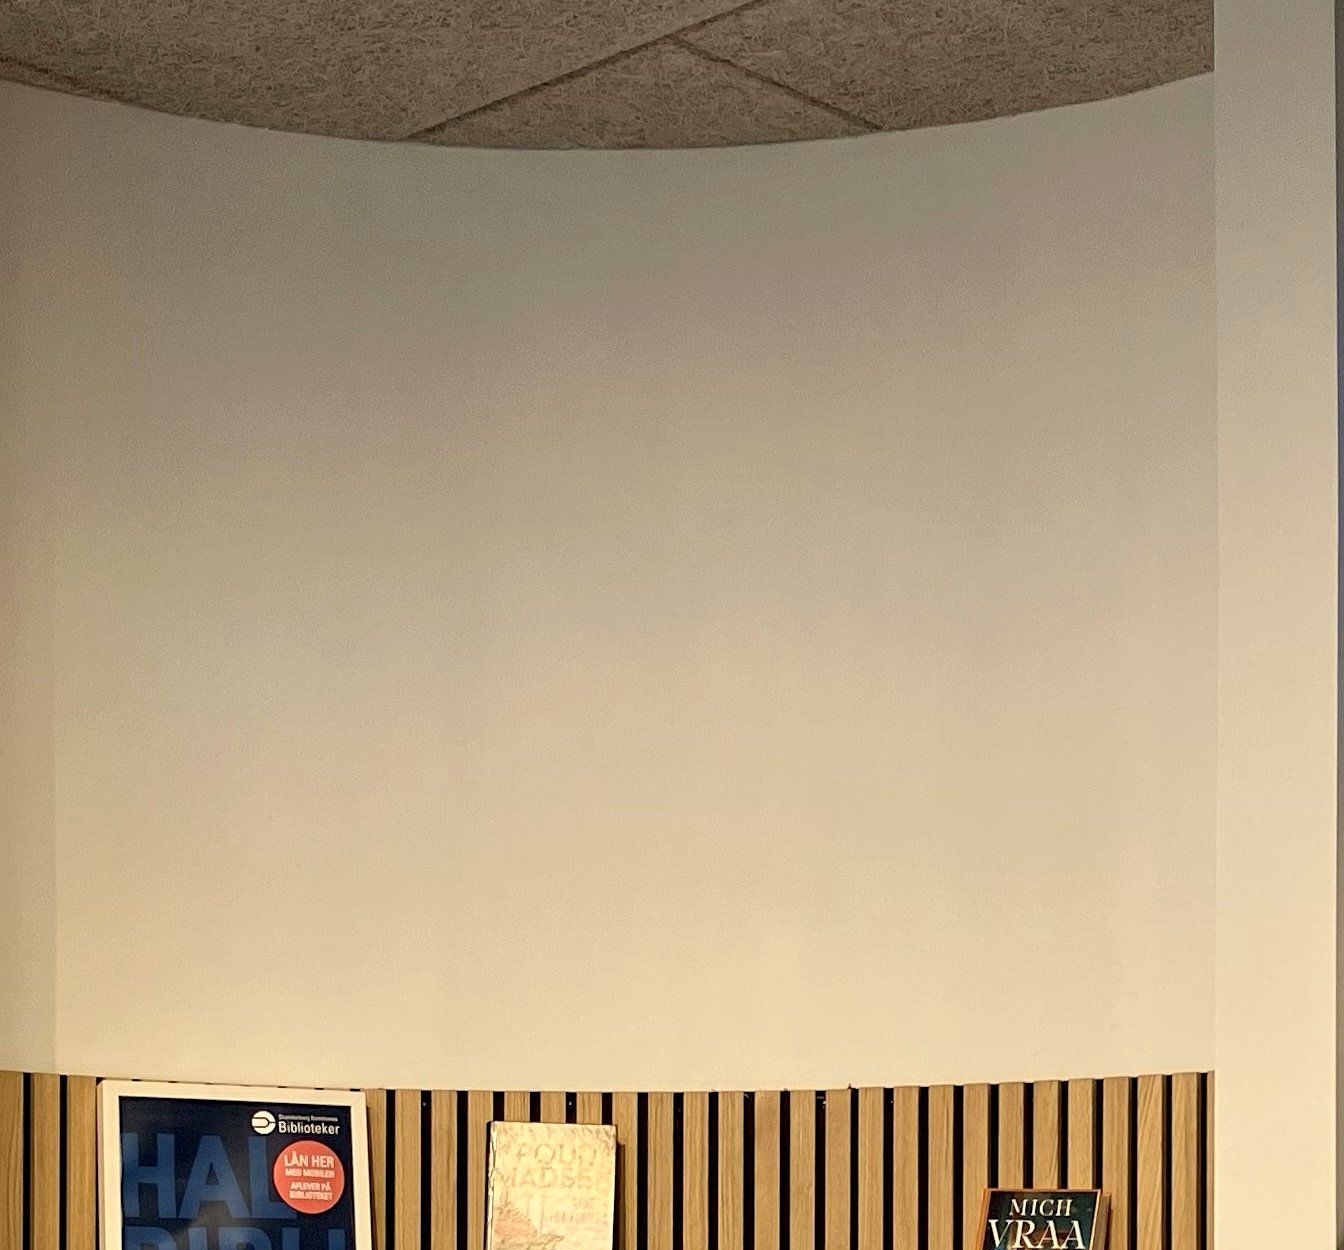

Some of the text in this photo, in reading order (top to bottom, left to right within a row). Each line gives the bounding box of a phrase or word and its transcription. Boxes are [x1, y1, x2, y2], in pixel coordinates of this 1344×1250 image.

[278, 1121, 340, 1135] Biblioteker
[284, 1151, 334, 1168] LÅN HER
[122, 1132, 297, 1220] HAL
[1009, 1199, 1073, 1216] MICH
[988, 1219, 1086, 1250] VRAA
